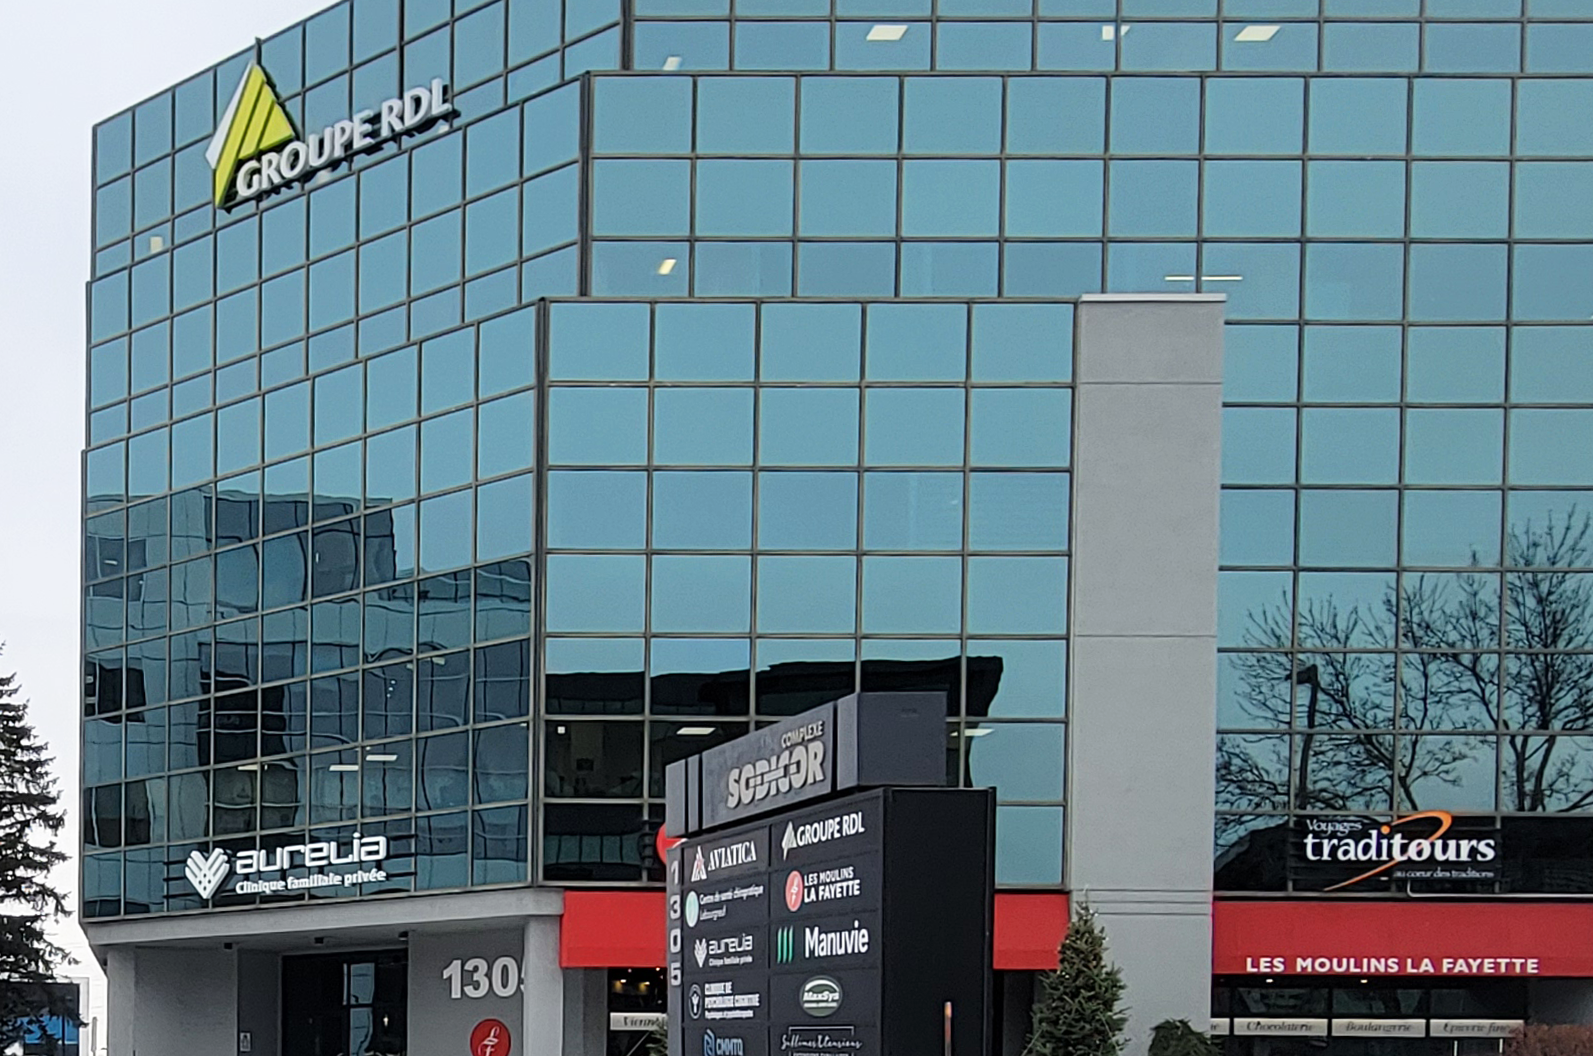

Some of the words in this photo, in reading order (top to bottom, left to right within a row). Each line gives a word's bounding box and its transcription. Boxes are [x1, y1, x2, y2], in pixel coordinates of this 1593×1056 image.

[236, 109, 374, 198] GROUPE
[381, 77, 453, 137] RDL
[781, 720, 825, 748] COMPLEXE
[727, 740, 825, 809] SODICOR
[796, 816, 841, 847] GROUPE
[842, 811, 866, 837] RDL
[1306, 818, 1363, 836] Voyages
[707, 840, 757, 871] AVIATICA
[1303, 825, 1496, 861] traditours
[235, 880, 286, 895] Clinique
[287, 873, 342, 889] familiale
[343, 868, 387, 887] privée
[804, 872, 818, 886] LES
[819, 866, 854, 884] MOULINS
[804, 887, 817, 903] LA
[818, 879, 861, 901] FAYETTE
[805, 919, 870, 958] Manuvie
[443, 956, 524, 999] 130
[1246, 957, 1285, 973] LES
[1296, 957, 1399, 973] MOULINS
[1406, 957, 1434, 973] LA
[1442, 958, 1539, 973] FAYETTE
